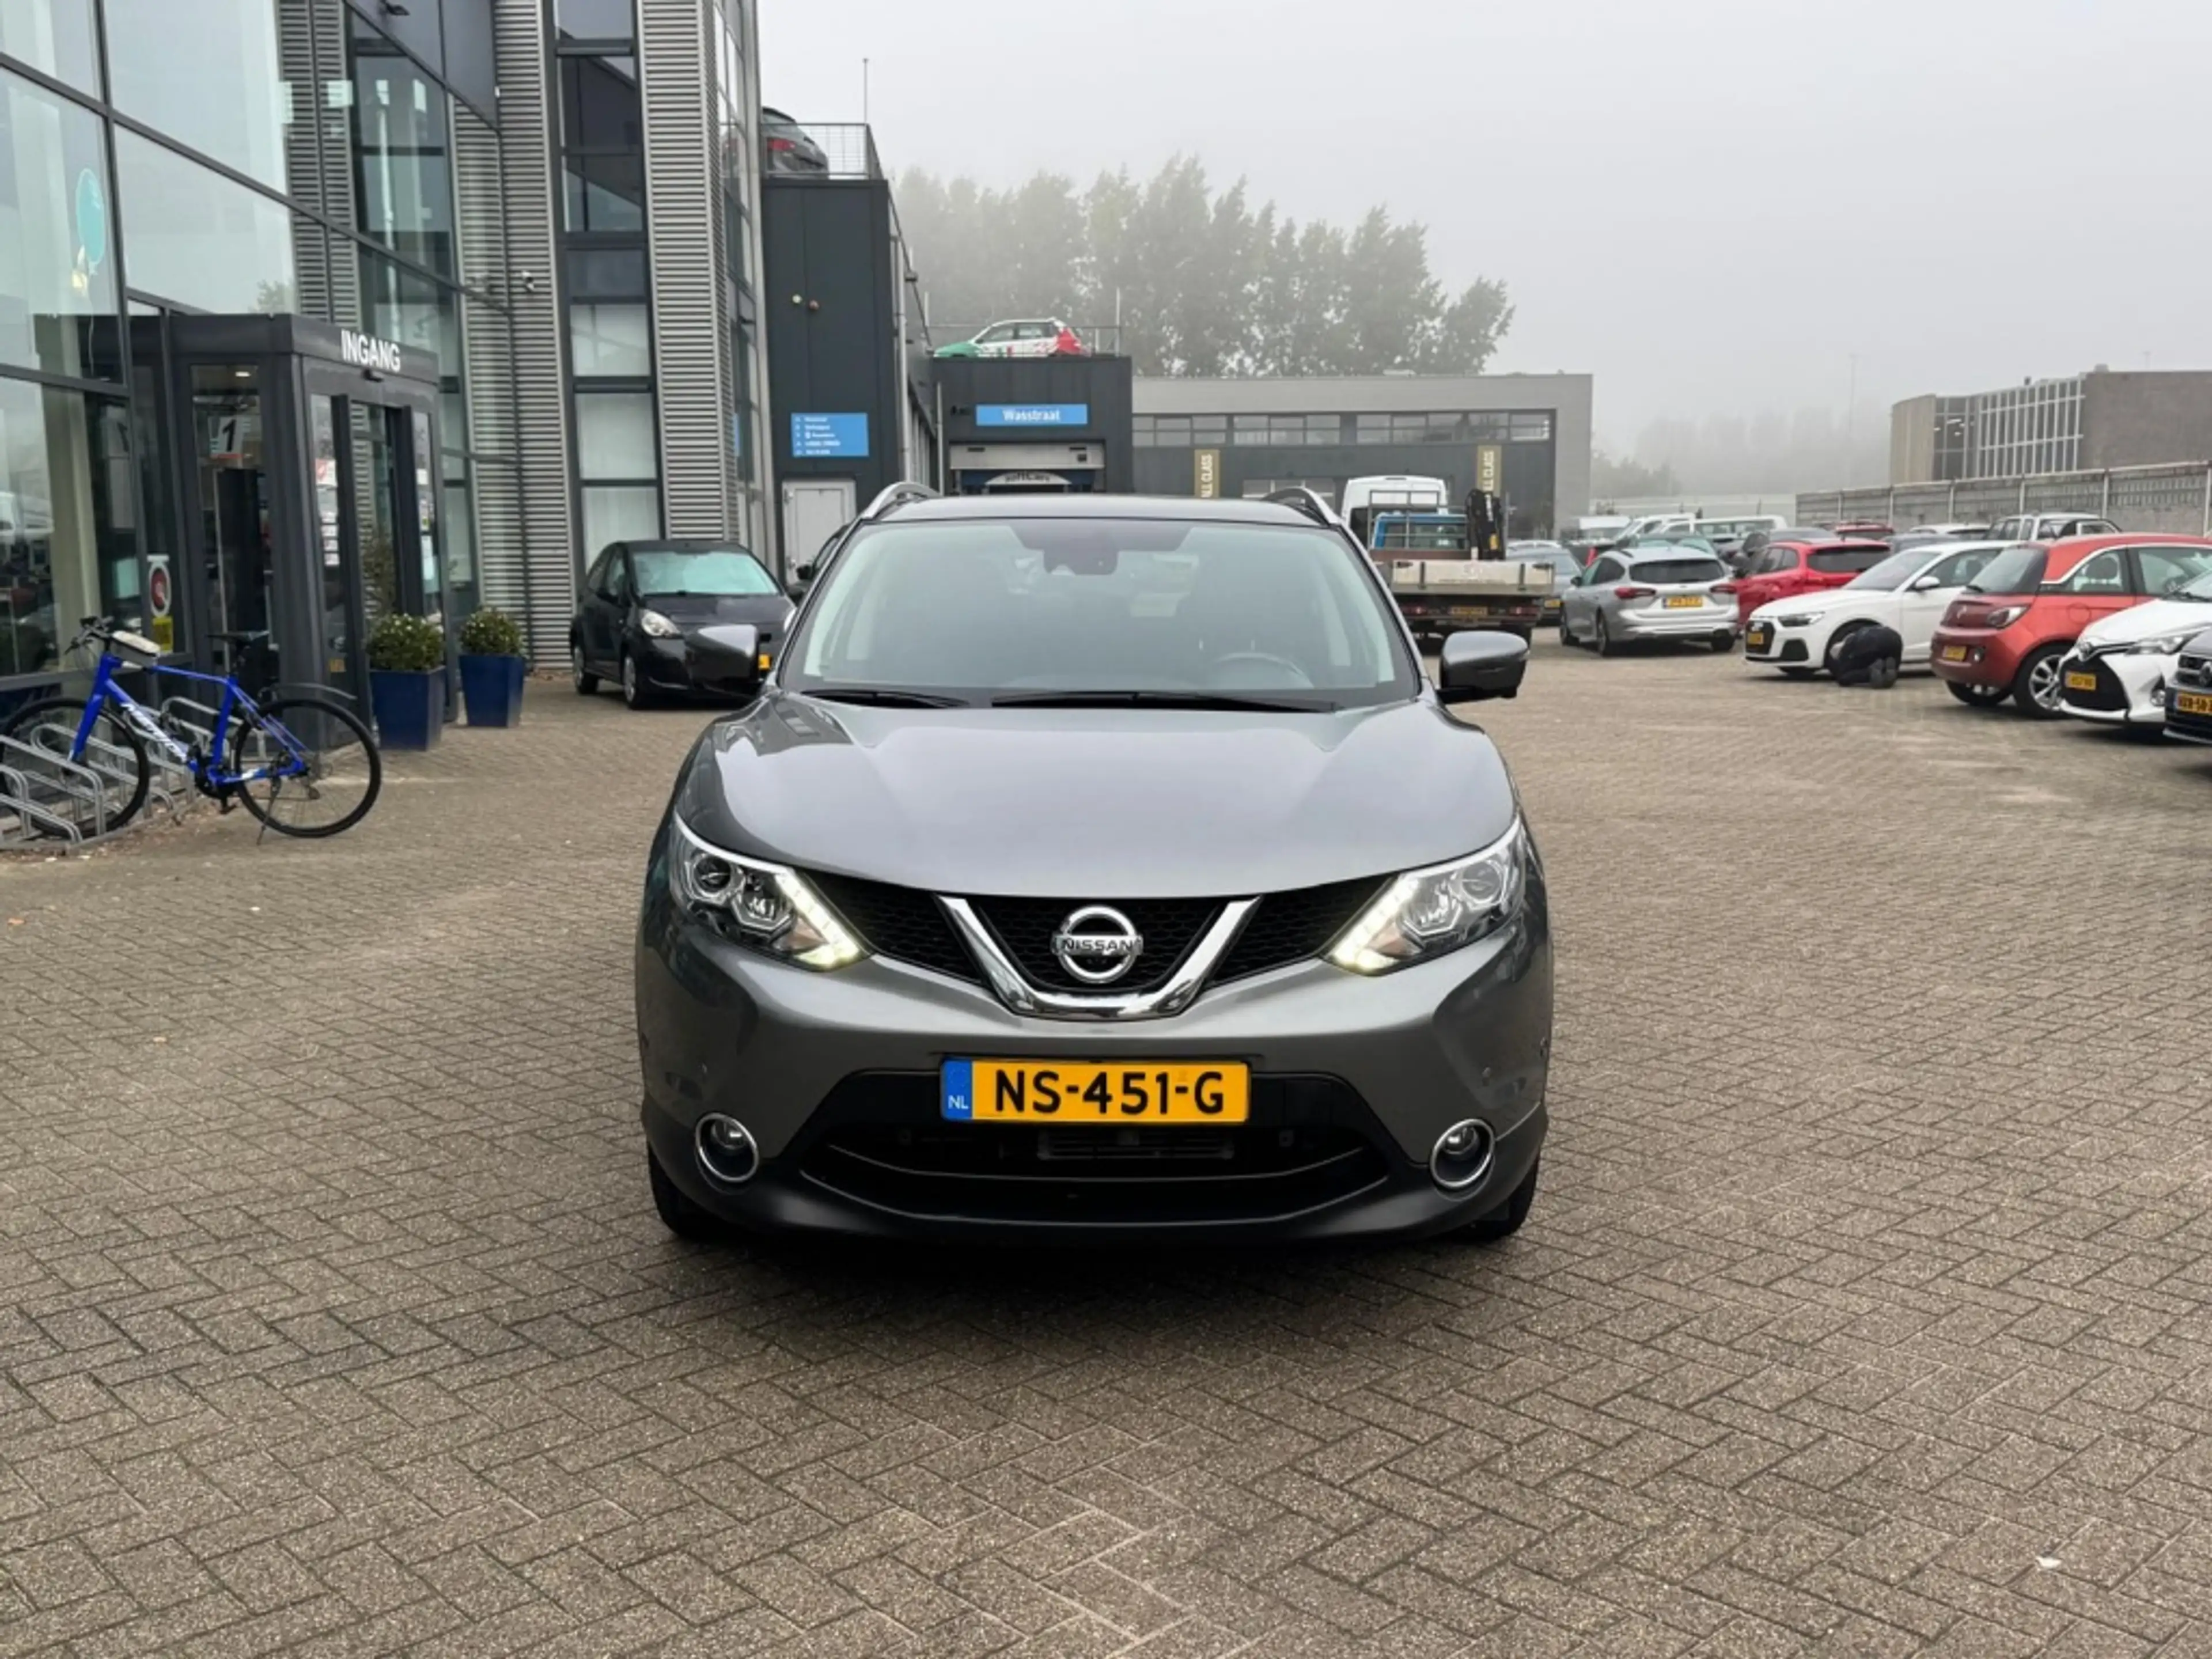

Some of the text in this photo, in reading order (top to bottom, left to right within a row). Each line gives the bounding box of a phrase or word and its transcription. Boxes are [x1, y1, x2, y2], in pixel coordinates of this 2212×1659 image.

[341, 328, 401, 373] INGANG
[1002, 409, 1060, 422] Wasstraat
[1200, 454, 1213, 483] CLASS
[1482, 450, 1494, 478] CLASS
[1063, 938, 1134, 950] NISSAN
[948, 1070, 1224, 1115] NL NS-451-G
